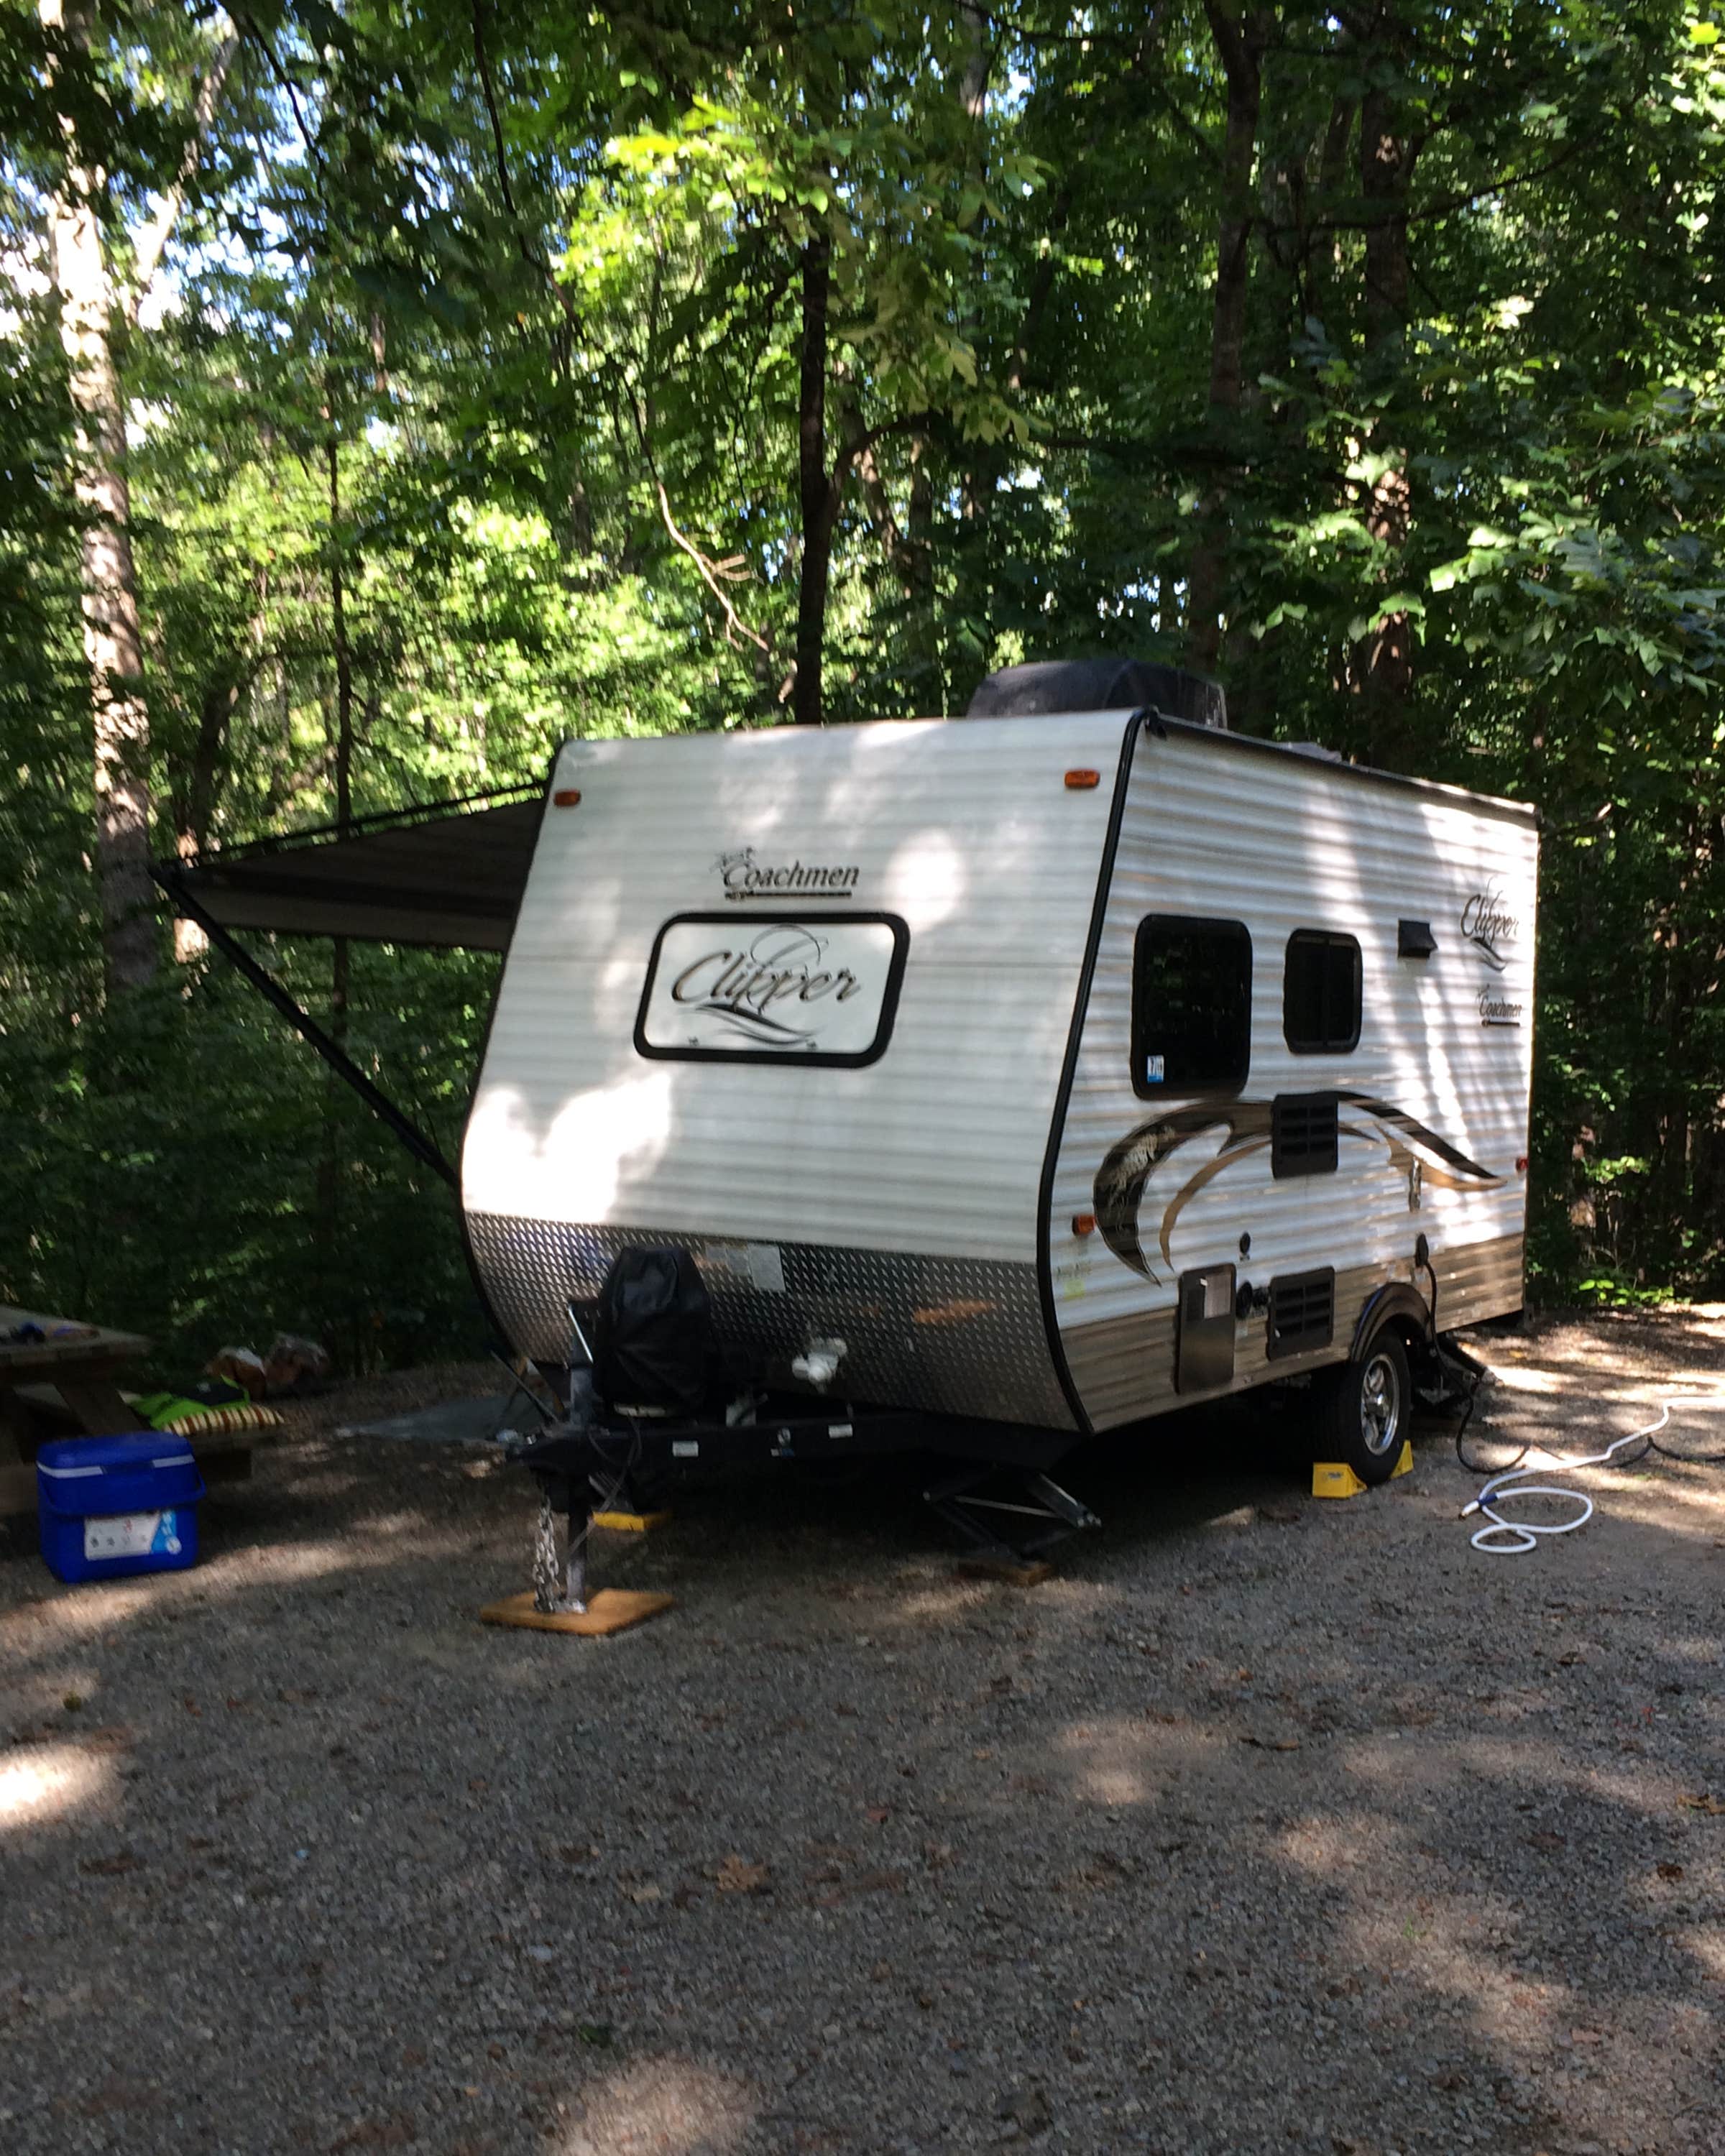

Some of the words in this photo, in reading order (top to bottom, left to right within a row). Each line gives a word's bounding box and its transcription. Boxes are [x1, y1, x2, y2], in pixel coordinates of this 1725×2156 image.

[722, 860, 860, 888] Coachmen
[1460, 884, 1519, 948] Clipper
[671, 923, 861, 1017] Clipper
[1479, 998, 1522, 1019] Coachmen
